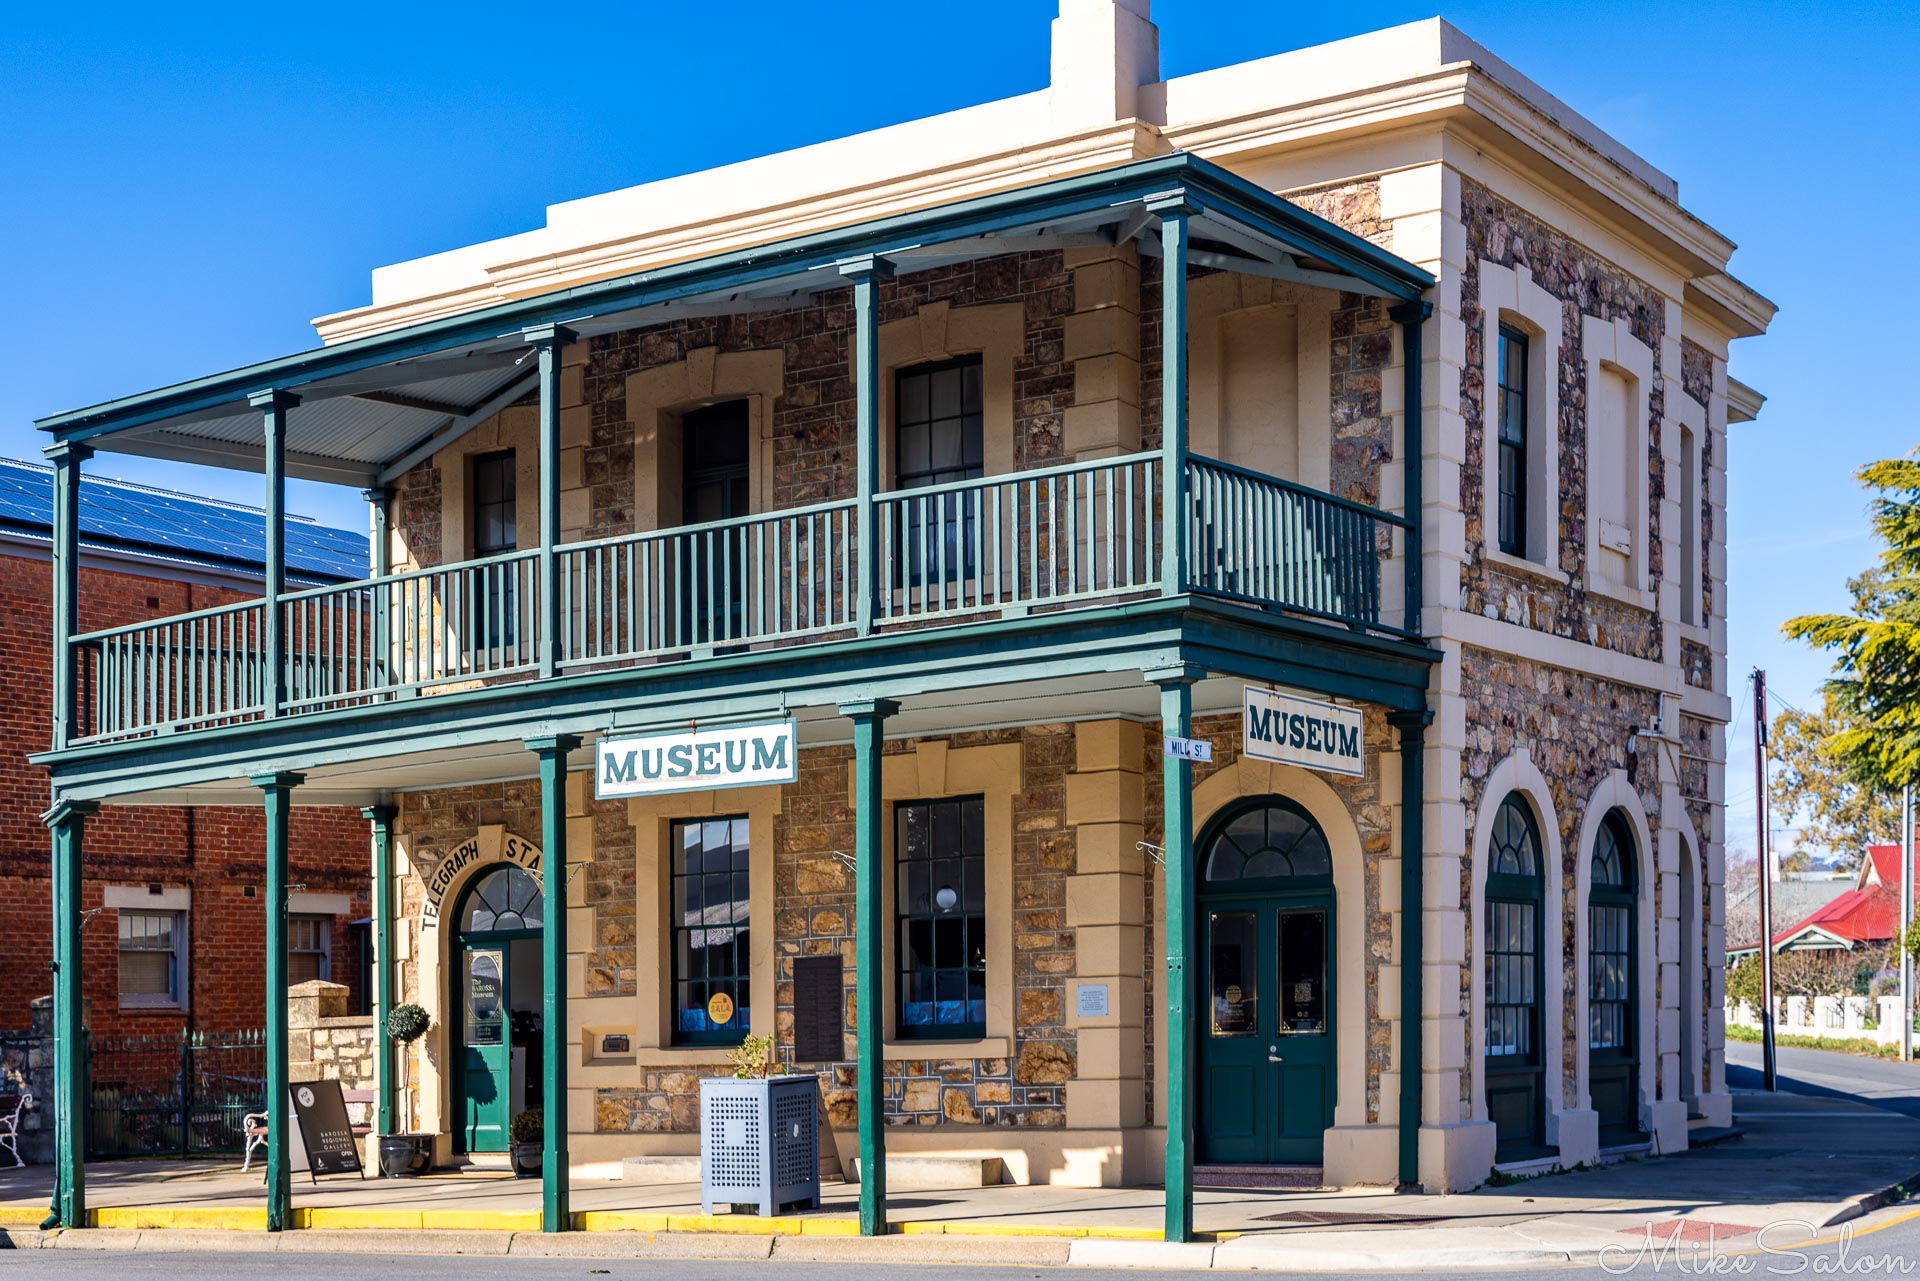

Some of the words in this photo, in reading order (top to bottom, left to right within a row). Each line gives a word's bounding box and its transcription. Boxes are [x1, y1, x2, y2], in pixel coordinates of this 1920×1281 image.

[1171, 741, 1190, 755] MILL
[1250, 705, 1359, 758] MUSEUM
[604, 735, 788, 784] MUSEUM
[422, 841, 479, 931] TELEGRAPH
